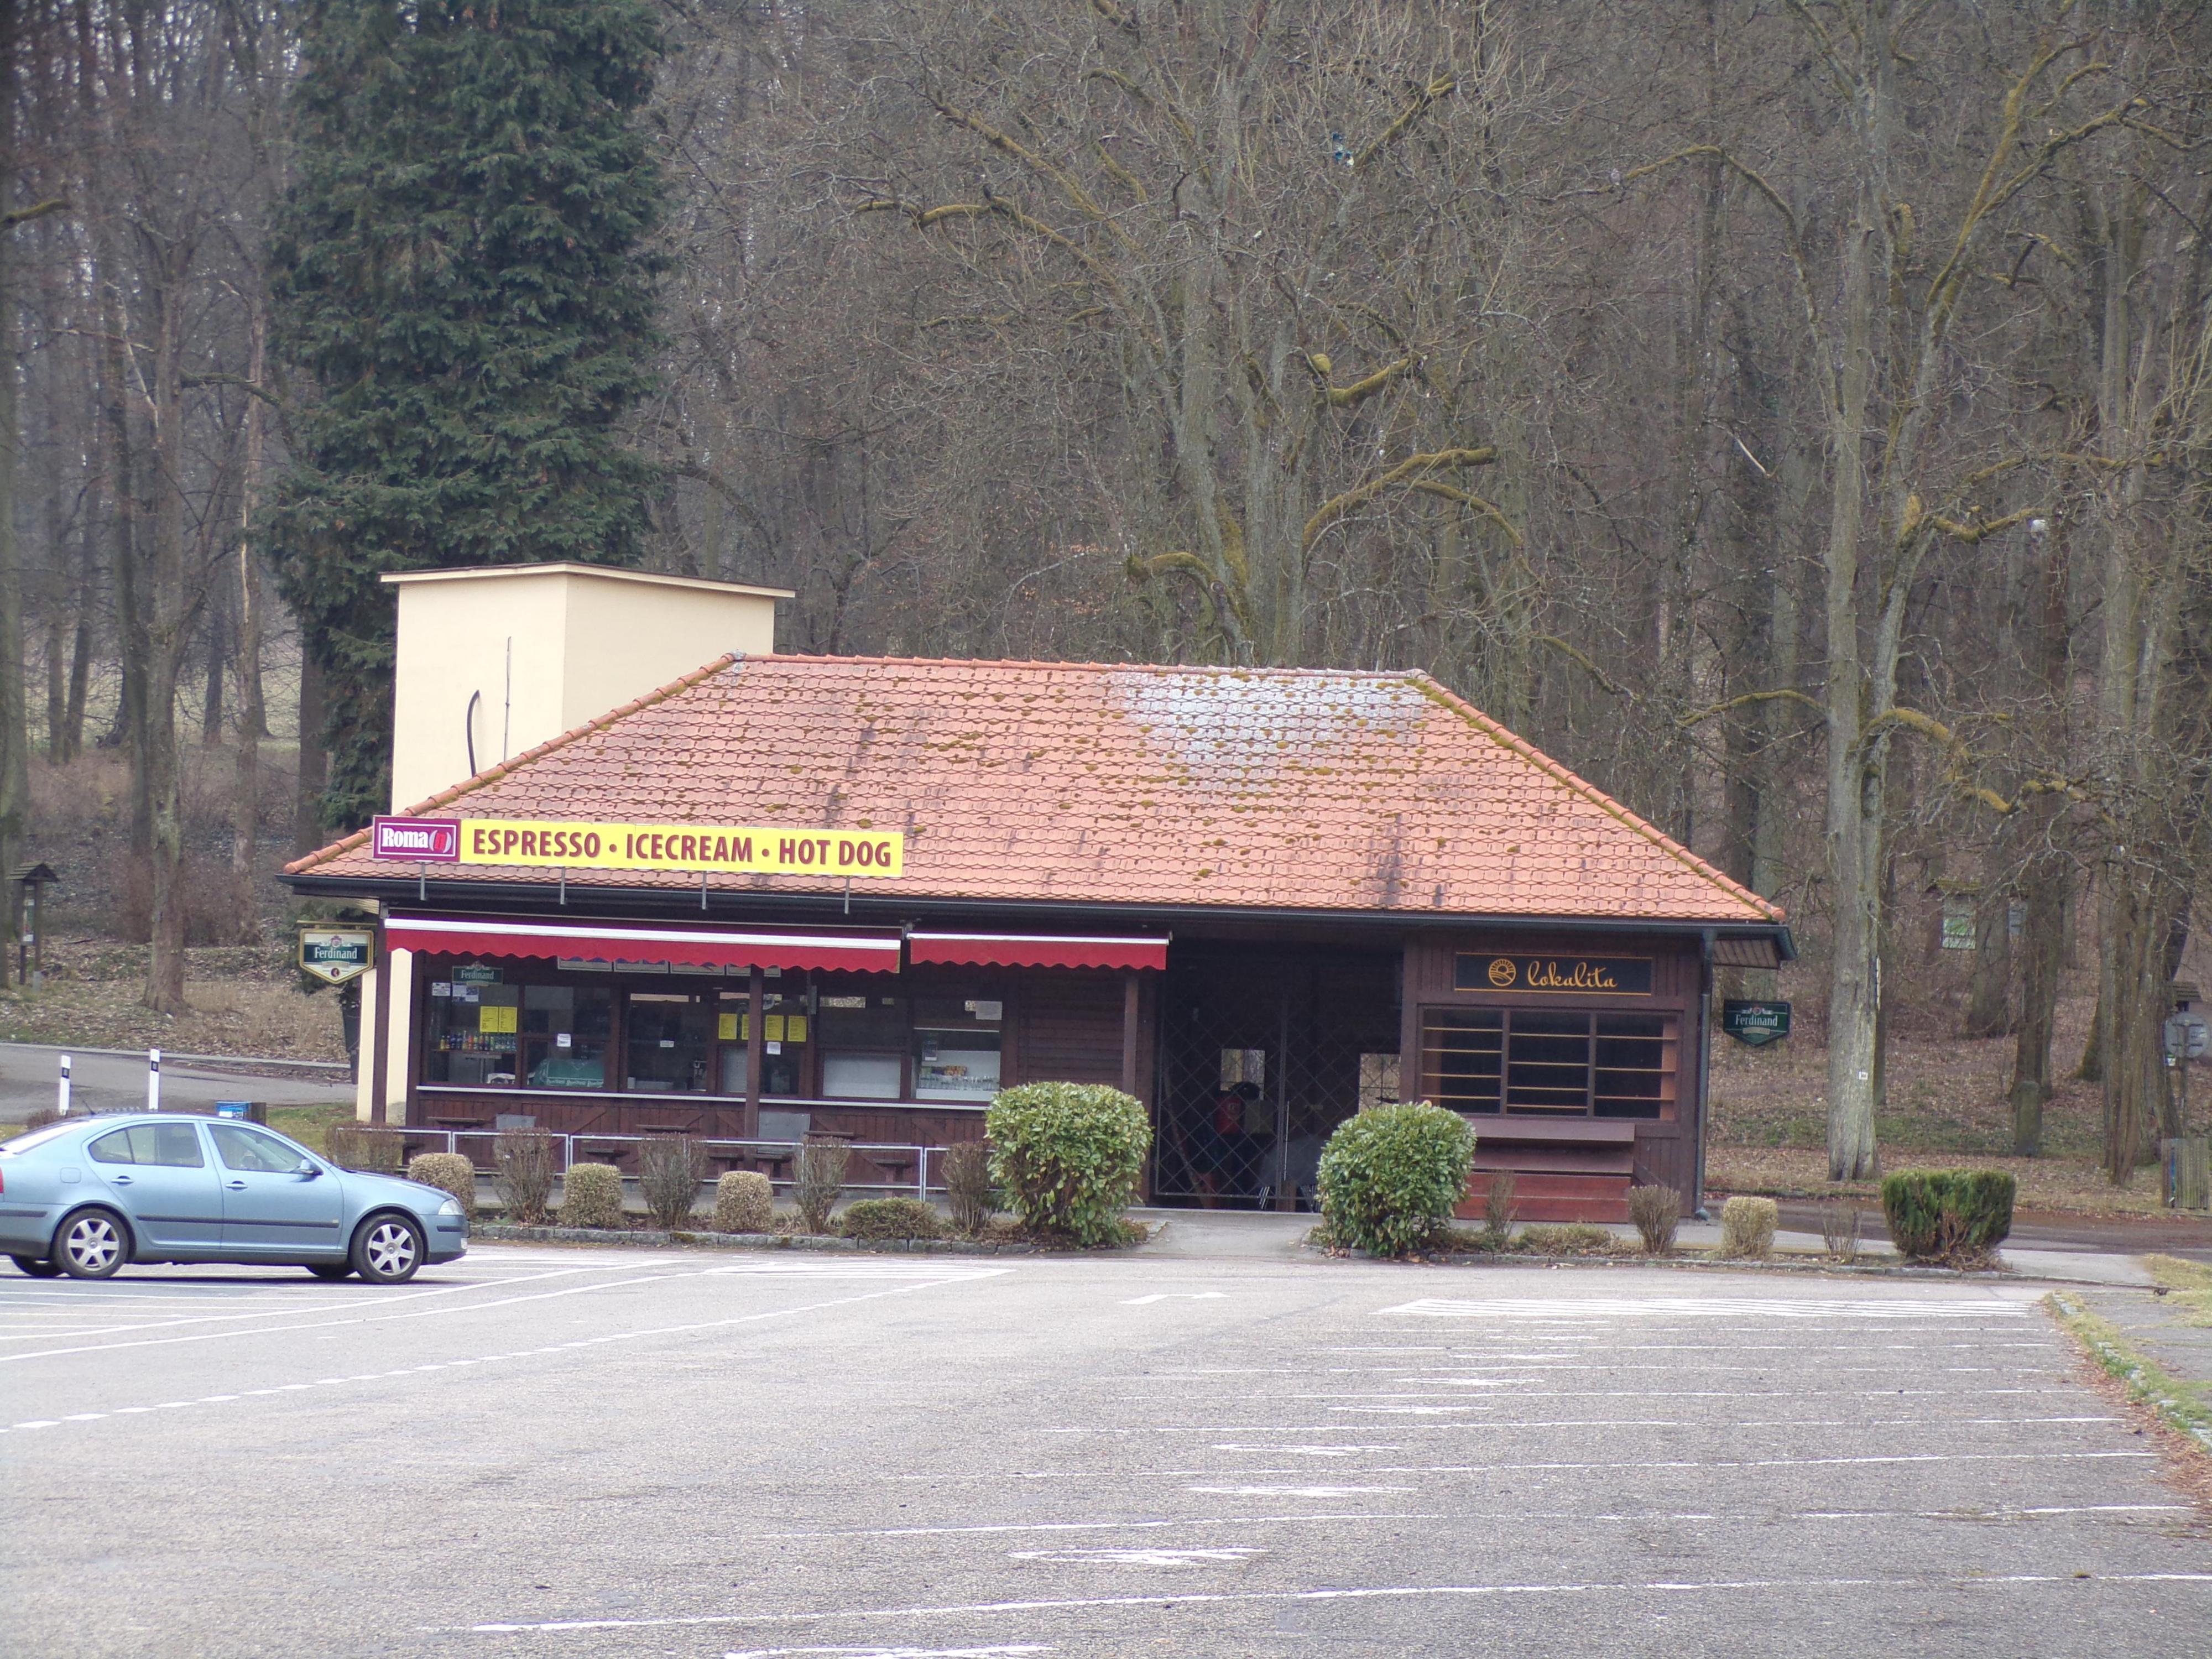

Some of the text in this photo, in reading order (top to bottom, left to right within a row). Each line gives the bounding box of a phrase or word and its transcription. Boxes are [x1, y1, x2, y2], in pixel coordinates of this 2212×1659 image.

[382, 828, 429, 848] Roma
[473, 829, 891, 867] ESPRESSO ICECREAM HOT DOG
[314, 947, 357, 959] Ferdinand
[461, 970, 494, 979] Ferdinand
[1735, 1014, 1778, 1026] Ferdinand
